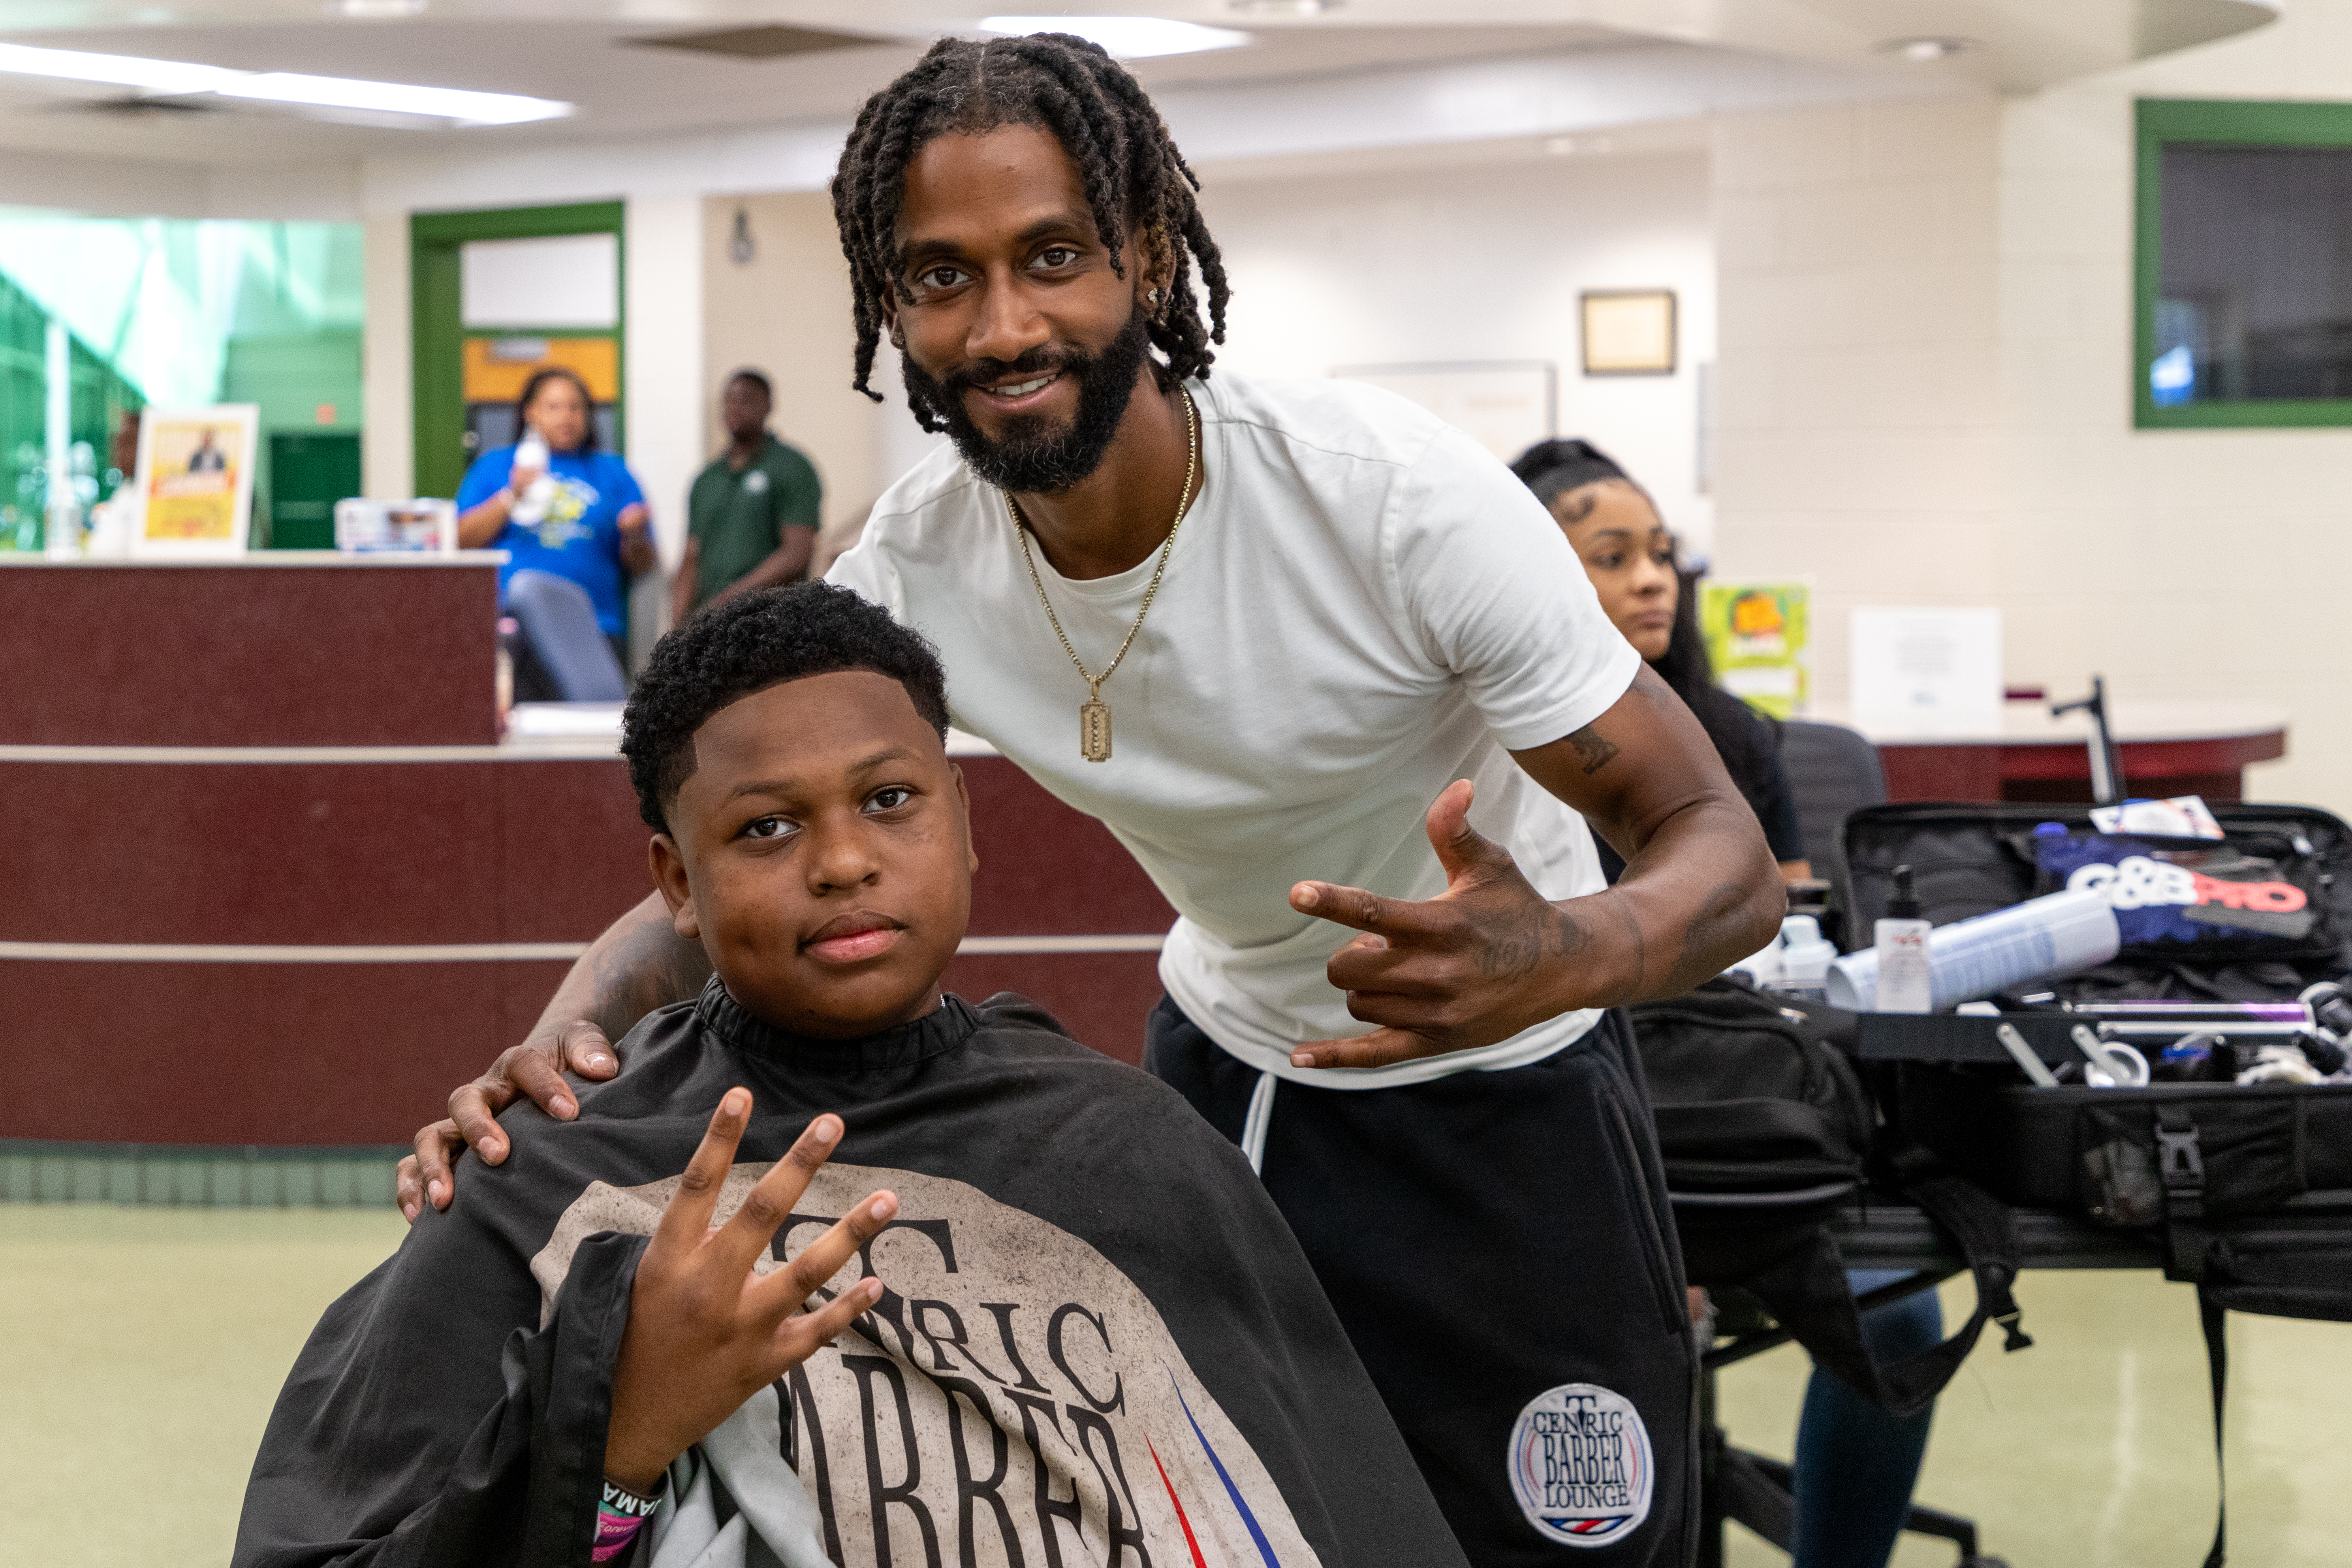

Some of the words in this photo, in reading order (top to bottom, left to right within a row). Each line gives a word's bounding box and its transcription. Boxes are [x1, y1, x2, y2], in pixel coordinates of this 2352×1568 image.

[1533, 1411, 1623, 1434] CENRIC
[772, 1354, 1152, 1568] ARBER
[1543, 1433, 1628, 1485] BARBER
[604, 1482, 662, 1517] AMA
[1545, 1485, 1630, 1508] LOUNGE
